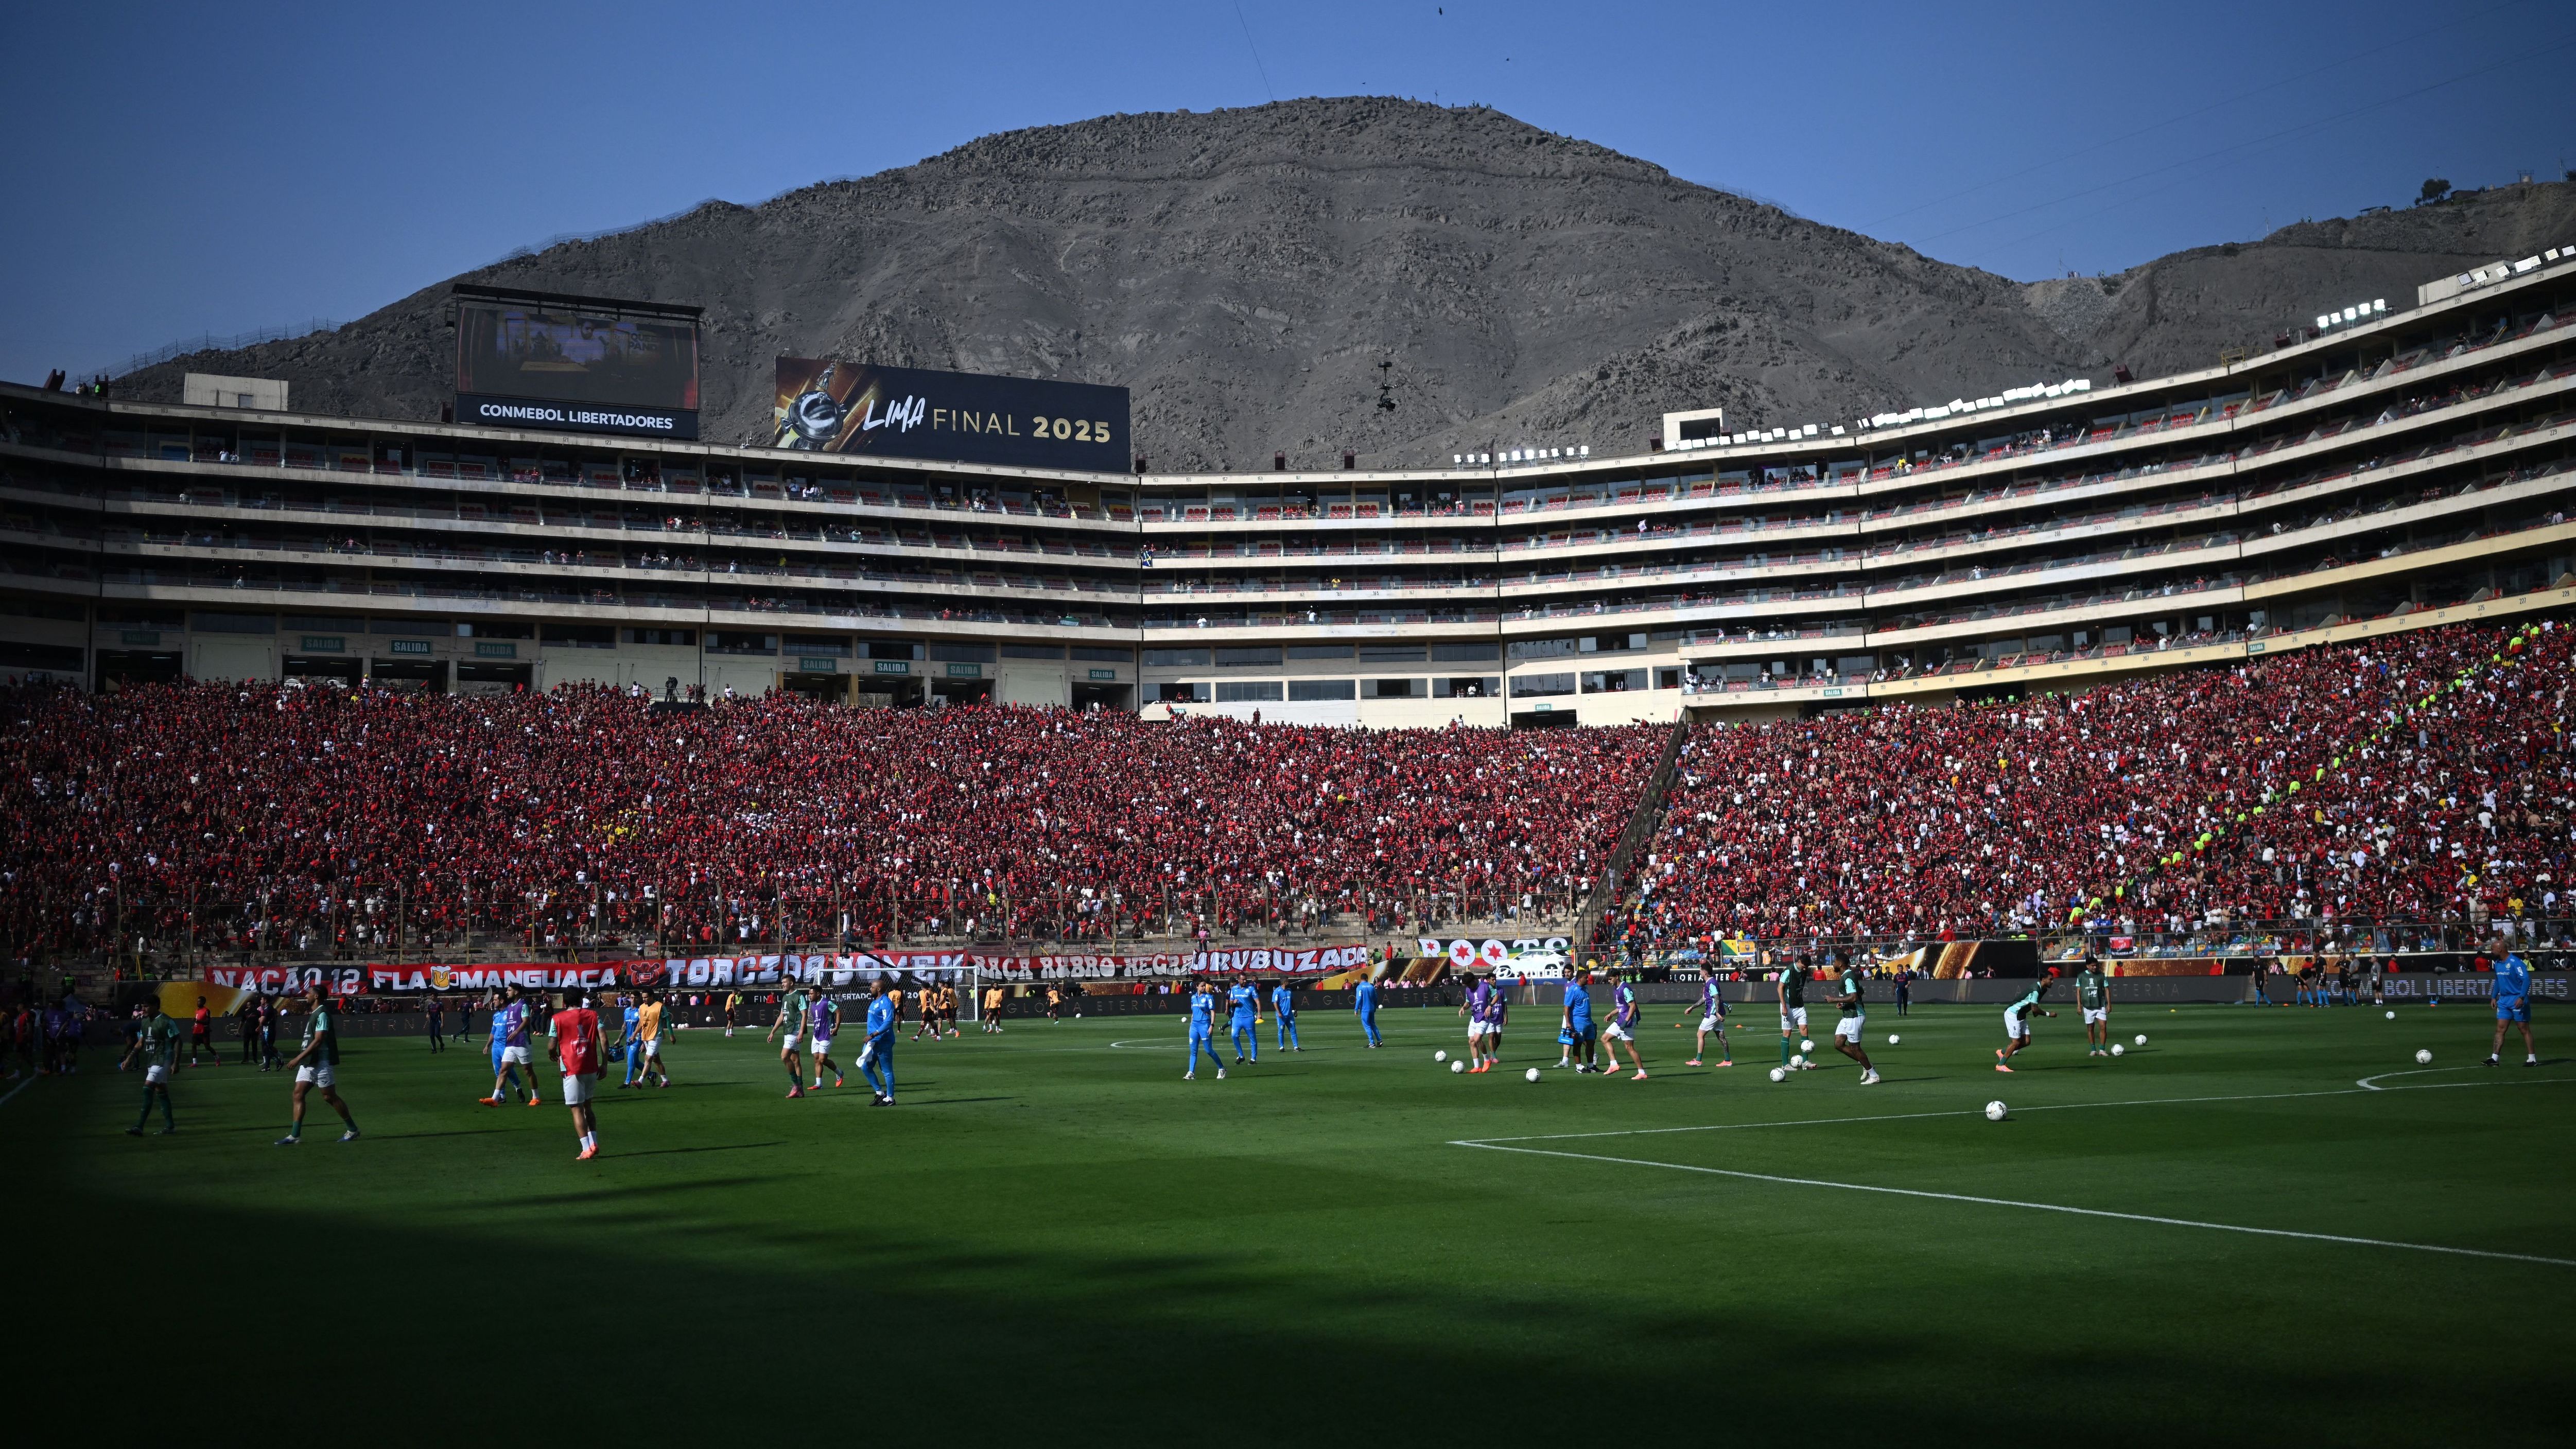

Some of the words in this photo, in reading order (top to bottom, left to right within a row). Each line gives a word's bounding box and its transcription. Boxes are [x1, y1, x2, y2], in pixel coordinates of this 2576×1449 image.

[480, 404, 565, 422] CONMEBOL
[569, 410, 673, 429] LIBERTADORES
[863, 395, 926, 432] LIMA
[933, 408, 1020, 436] FINAL
[1033, 416, 1110, 443] 2025
[306, 639, 340, 649] SALIDA
[395, 642, 427, 652] SALIDA
[480, 644, 512, 655] SALIDA
[804, 659, 833, 669] SALIDA
[878, 663, 907, 672] SALIDA
[951, 665, 978, 674] SALIDA
[1040, 954, 1192, 979] RUBRO-NEGRA
[1192, 945, 1367, 972] URUBUZADA
[666, 955, 825, 987] TORCIDA
[330, 968, 360, 994] 12
[374, 971, 427, 990] FLA
[460, 968, 616, 993] MANGUAÇA
[2326, 980, 2421, 996] COMBOL
[1301, 996, 1310, 1006] A
[1322, 992, 1390, 1005] GLÓA
[1404, 990, 1464, 1003] ETERNA
[2112, 984, 2179, 997] ETERNA
[1006, 1000, 1082, 1013] GLÓIA
[1097, 999, 1168, 1011] ETERNA
